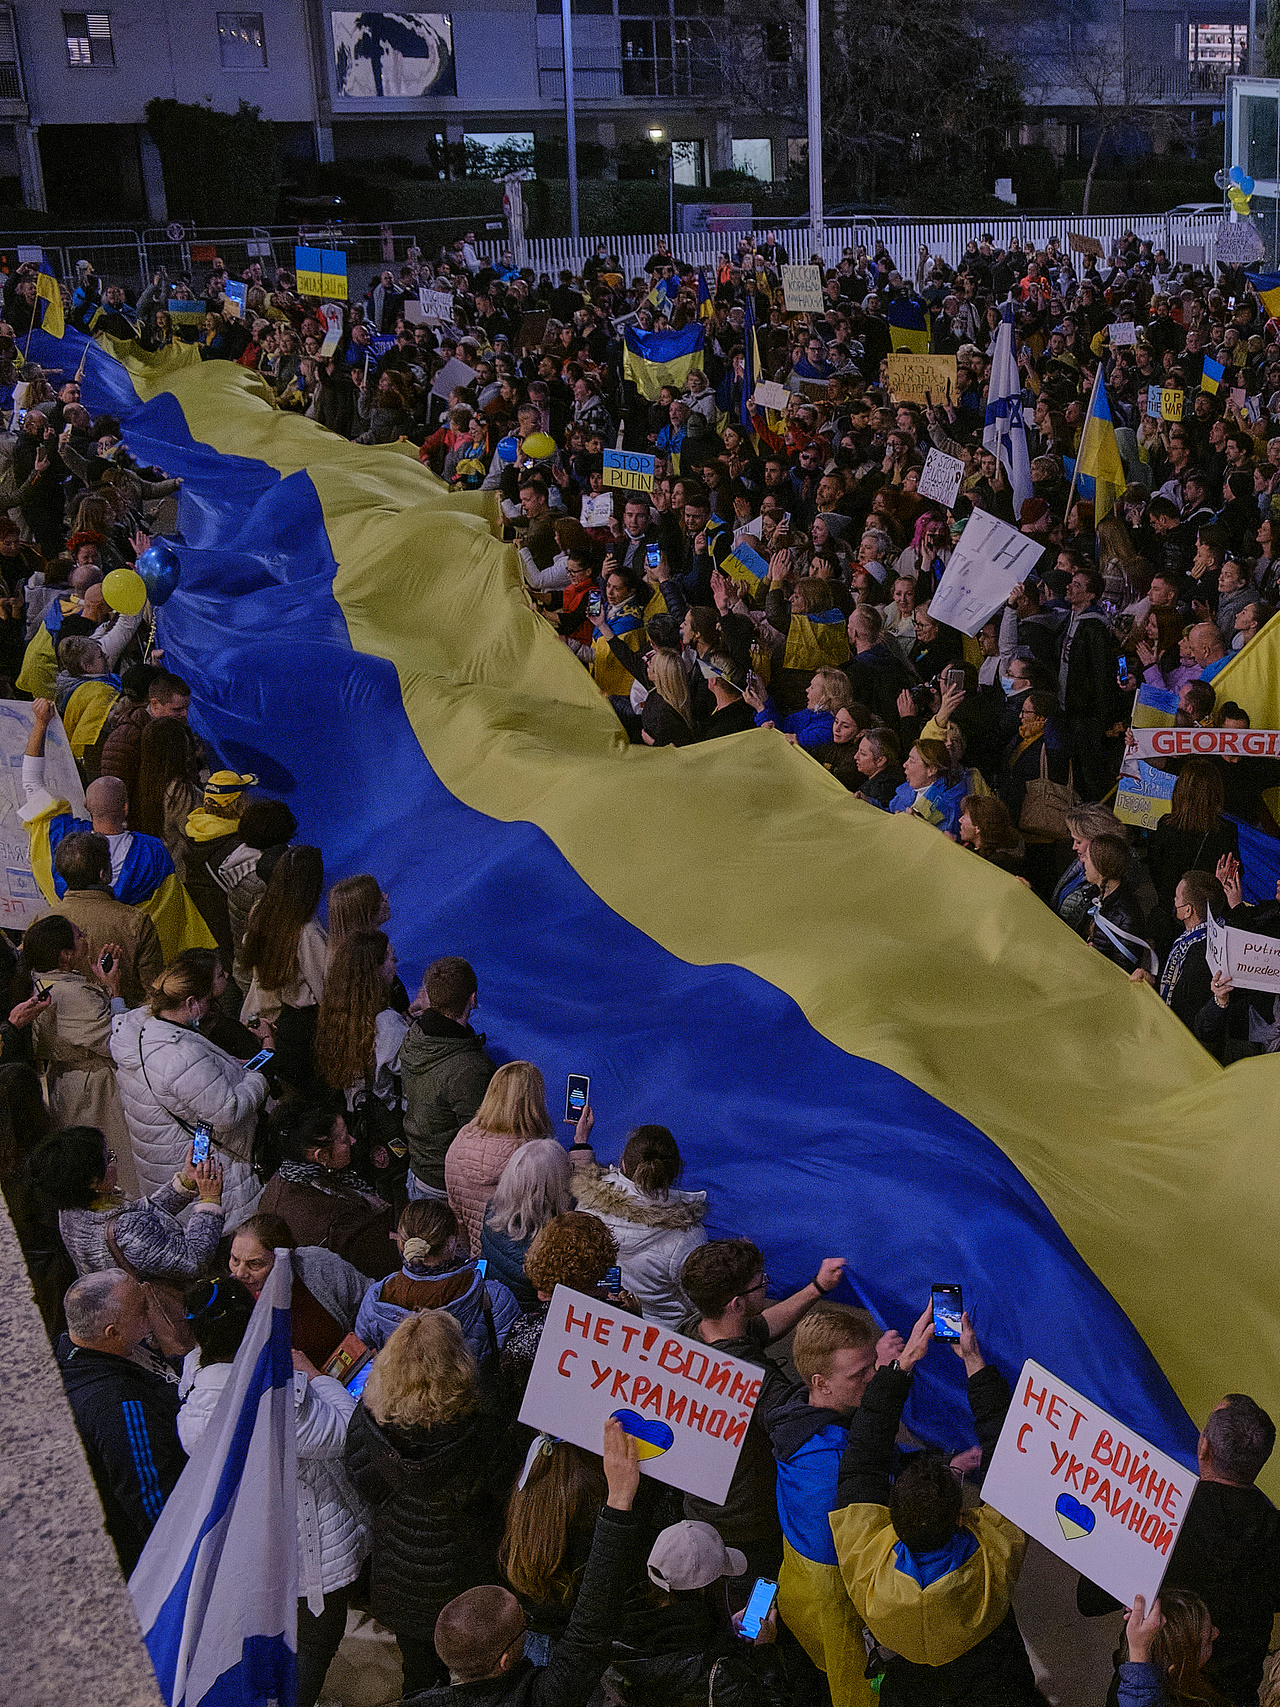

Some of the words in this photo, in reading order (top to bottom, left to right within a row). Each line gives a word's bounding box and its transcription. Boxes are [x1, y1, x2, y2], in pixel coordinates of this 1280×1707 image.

[1148, 401, 1161, 413] THE
[1165, 403, 1182, 415] WAR
[1150, 391, 1180, 402] STOP
[610, 454, 650, 473] STOP
[611, 470, 651, 490] PUTIN
[655, 1338, 763, 1410] ВОЙНЕ
[557, 1349, 580, 1378] С
[589, 1361, 752, 1448] УКРАИНОЙ
[1023, 1376, 1089, 1440] НЕТ
[1092, 1430, 1184, 1519] ВОЙНЕ
[1016, 1423, 1034, 1454] С
[1050, 1440, 1178, 1556] УКРАИНОЙ
